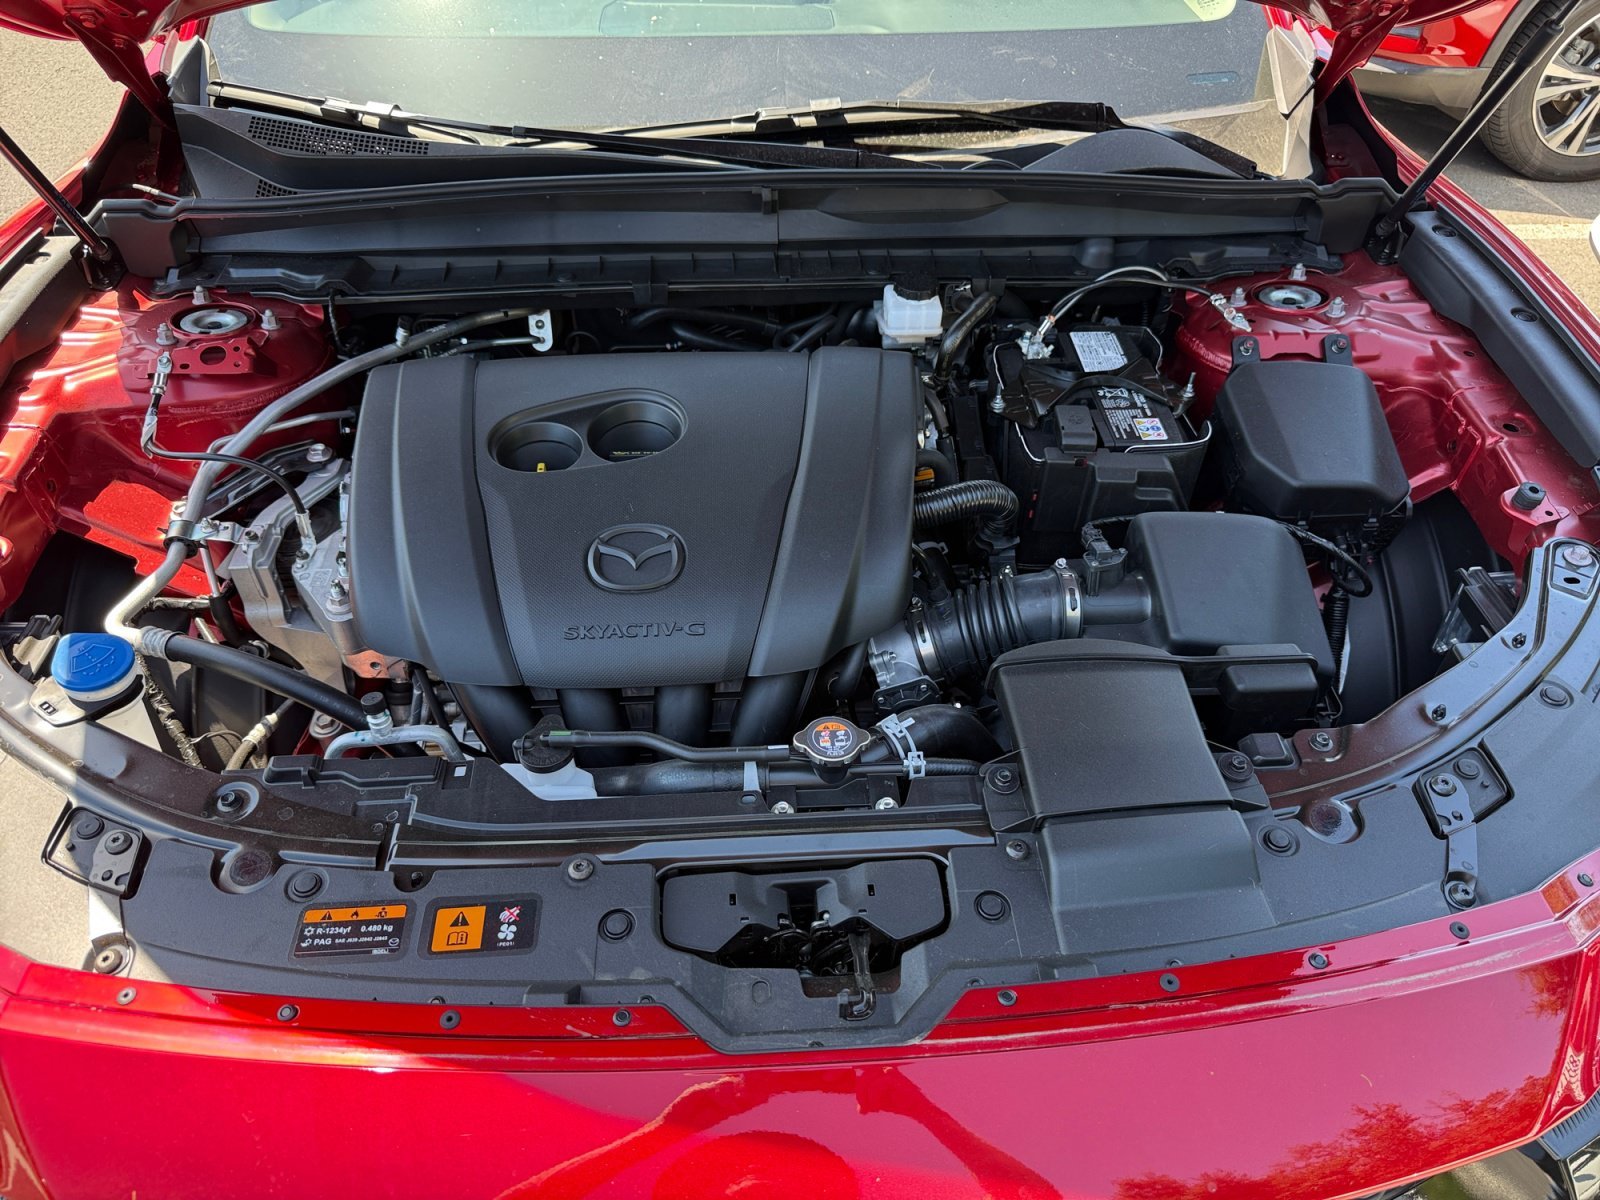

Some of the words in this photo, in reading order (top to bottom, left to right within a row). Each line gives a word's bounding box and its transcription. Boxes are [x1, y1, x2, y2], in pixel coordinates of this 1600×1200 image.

[564, 621, 706, 640] SKYACTIV-G
[316, 926, 352, 936] R-1234yf
[383, 924, 394, 933] kg
[313, 938, 332, 946] PAG
